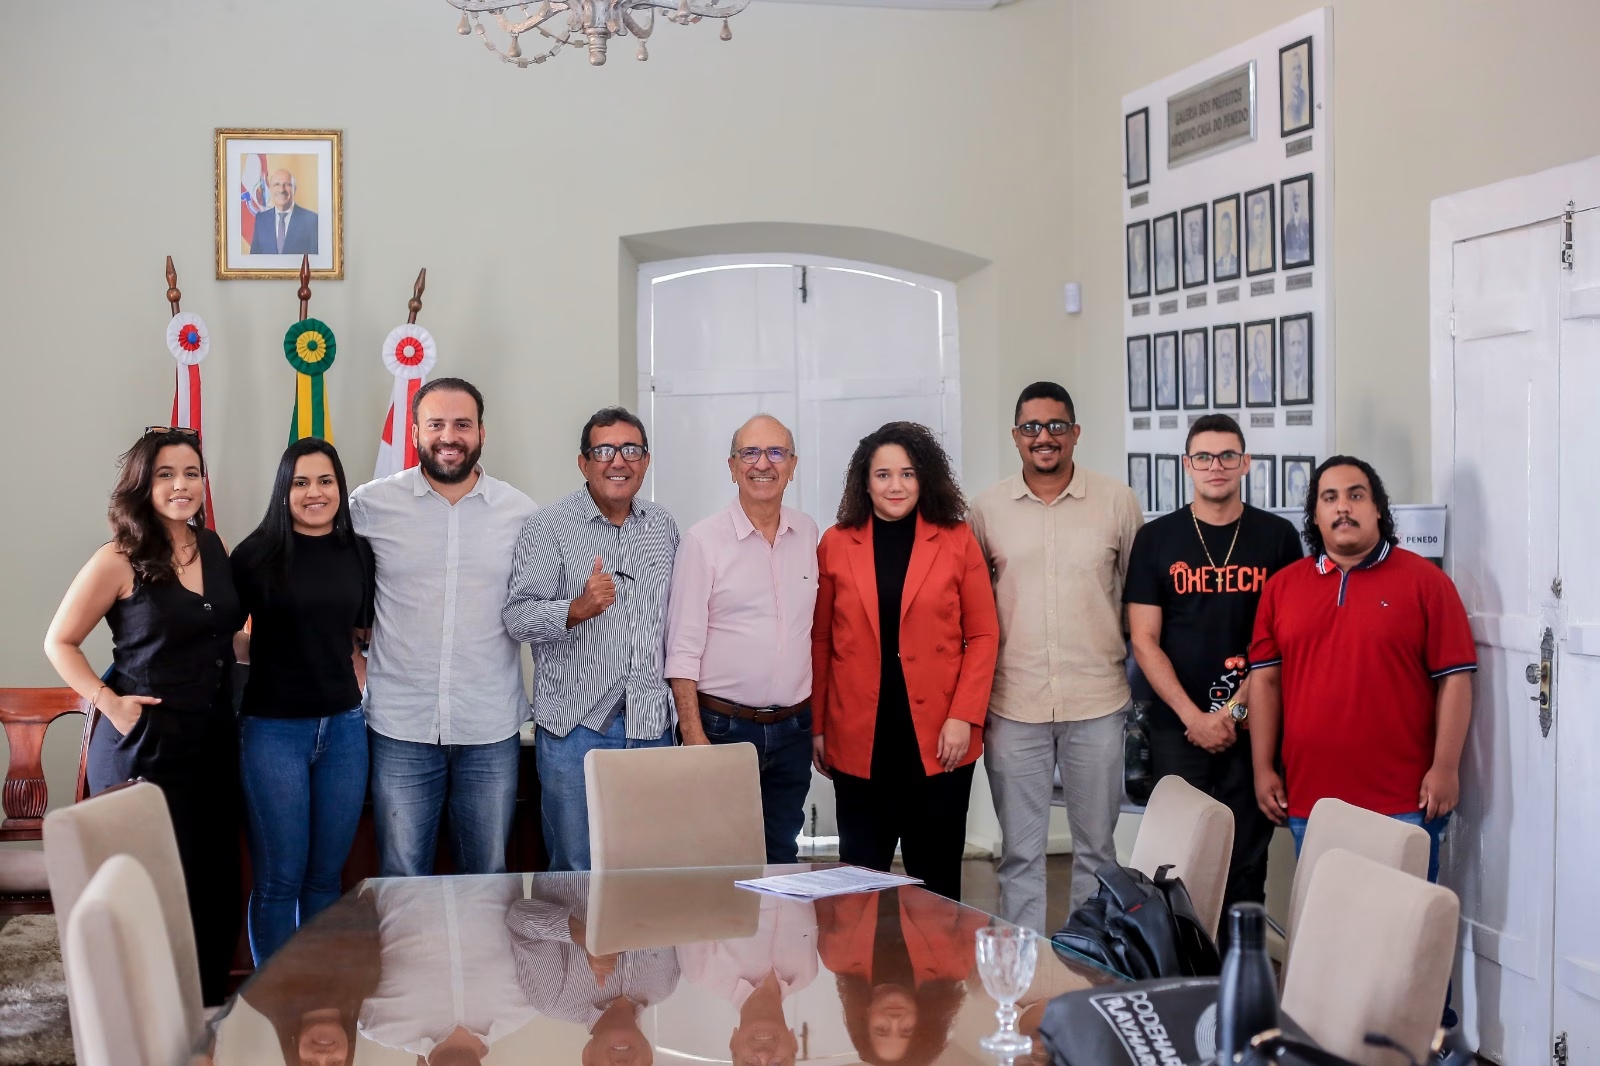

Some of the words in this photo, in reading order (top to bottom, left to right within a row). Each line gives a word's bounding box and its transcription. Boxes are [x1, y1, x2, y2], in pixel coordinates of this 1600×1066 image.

[1175, 105, 1198, 126] GALERIA
[1199, 100, 1211, 116] DOS
[1212, 87, 1243, 112] PREFEITOS
[1172, 127, 1196, 147] ARQUIVO
[1197, 121, 1212, 138] CASA
[1213, 117, 1222, 132] DO
[1223, 107, 1248, 128] PENEDO
[1406, 535, 1438, 544] PENEDO
